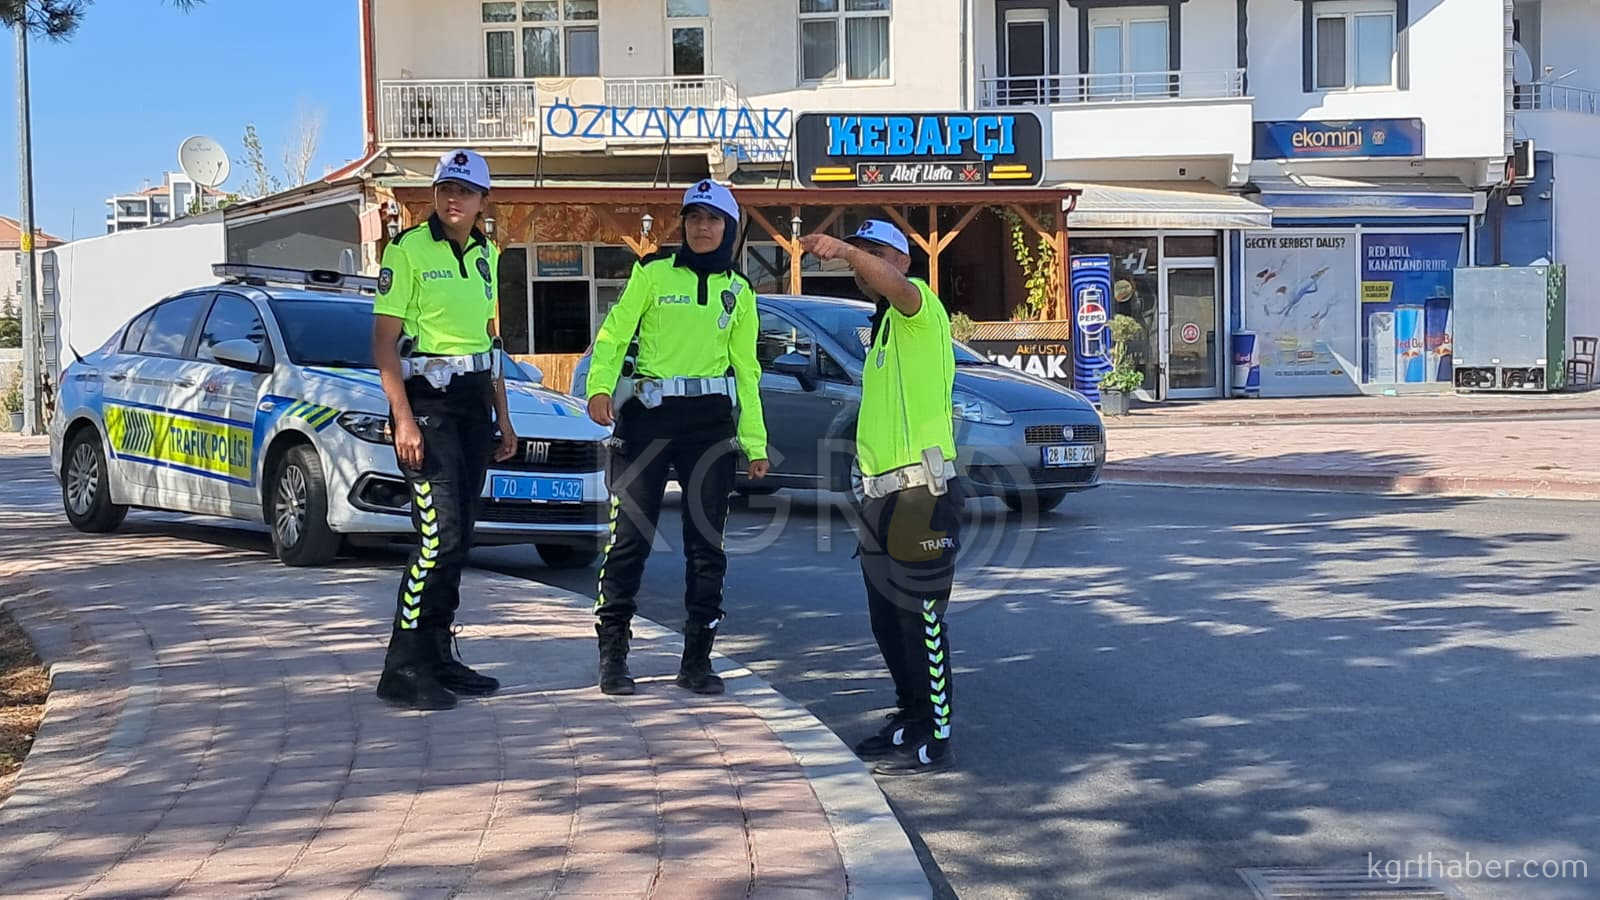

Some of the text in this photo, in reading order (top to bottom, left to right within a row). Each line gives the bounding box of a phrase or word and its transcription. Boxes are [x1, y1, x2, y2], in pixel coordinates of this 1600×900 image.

[546, 97, 788, 138] ÖZKAYMAK
[827, 115, 1015, 161] KEBAPÇI
[1292, 126, 1362, 147] ekomini
[890, 164, 922, 183] Akif
[923, 165, 952, 181] Usta
[1279, 237, 1313, 248] SERBEST
[1368, 246, 1410, 257] RED BULL
[1080, 314, 1105, 322] PEPSI
[1038, 345, 1067, 354] USTA
[526, 440, 551, 462] FIAT
[502, 479, 580, 498] 70 A 5432
